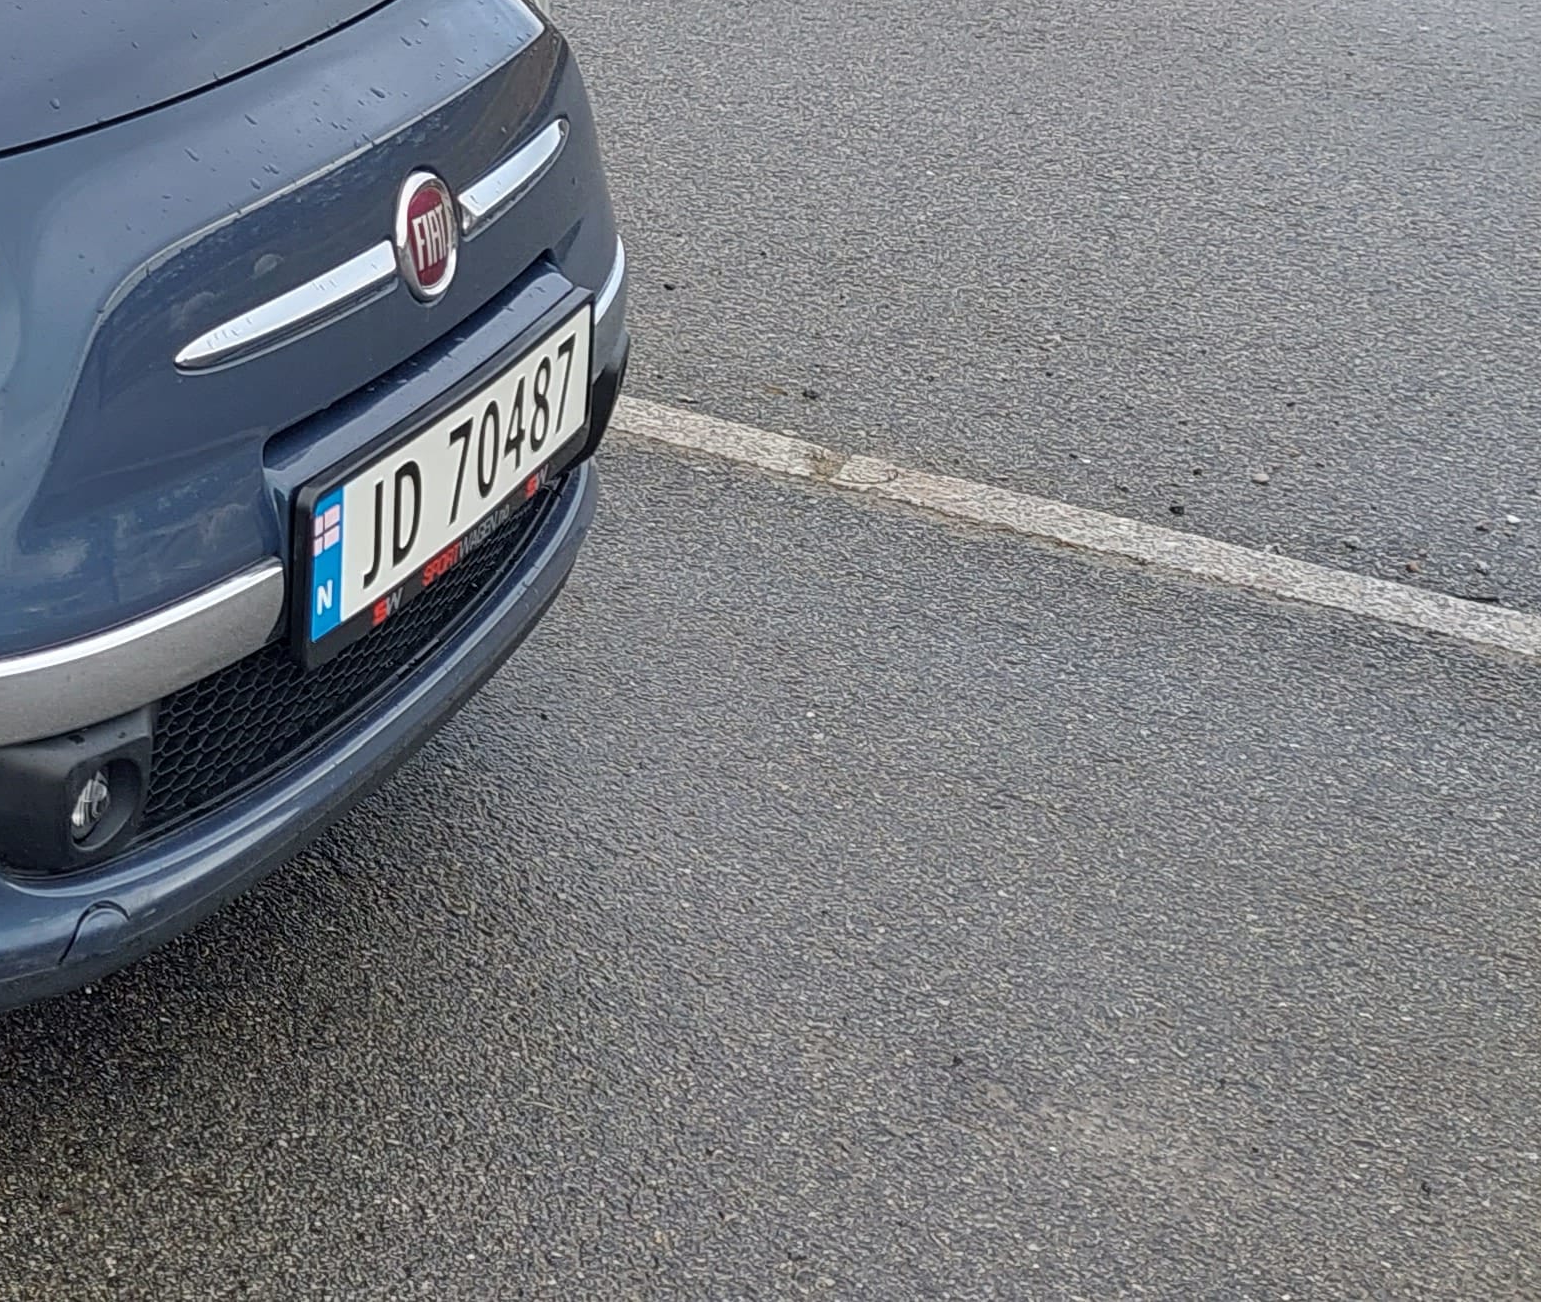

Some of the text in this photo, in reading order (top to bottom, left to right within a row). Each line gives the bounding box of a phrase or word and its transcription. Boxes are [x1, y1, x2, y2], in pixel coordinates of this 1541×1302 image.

[412, 202, 447, 272] FIAT
[363, 331, 577, 589] JD 70487
[316, 579, 334, 616] N
[372, 587, 404, 626] SW
